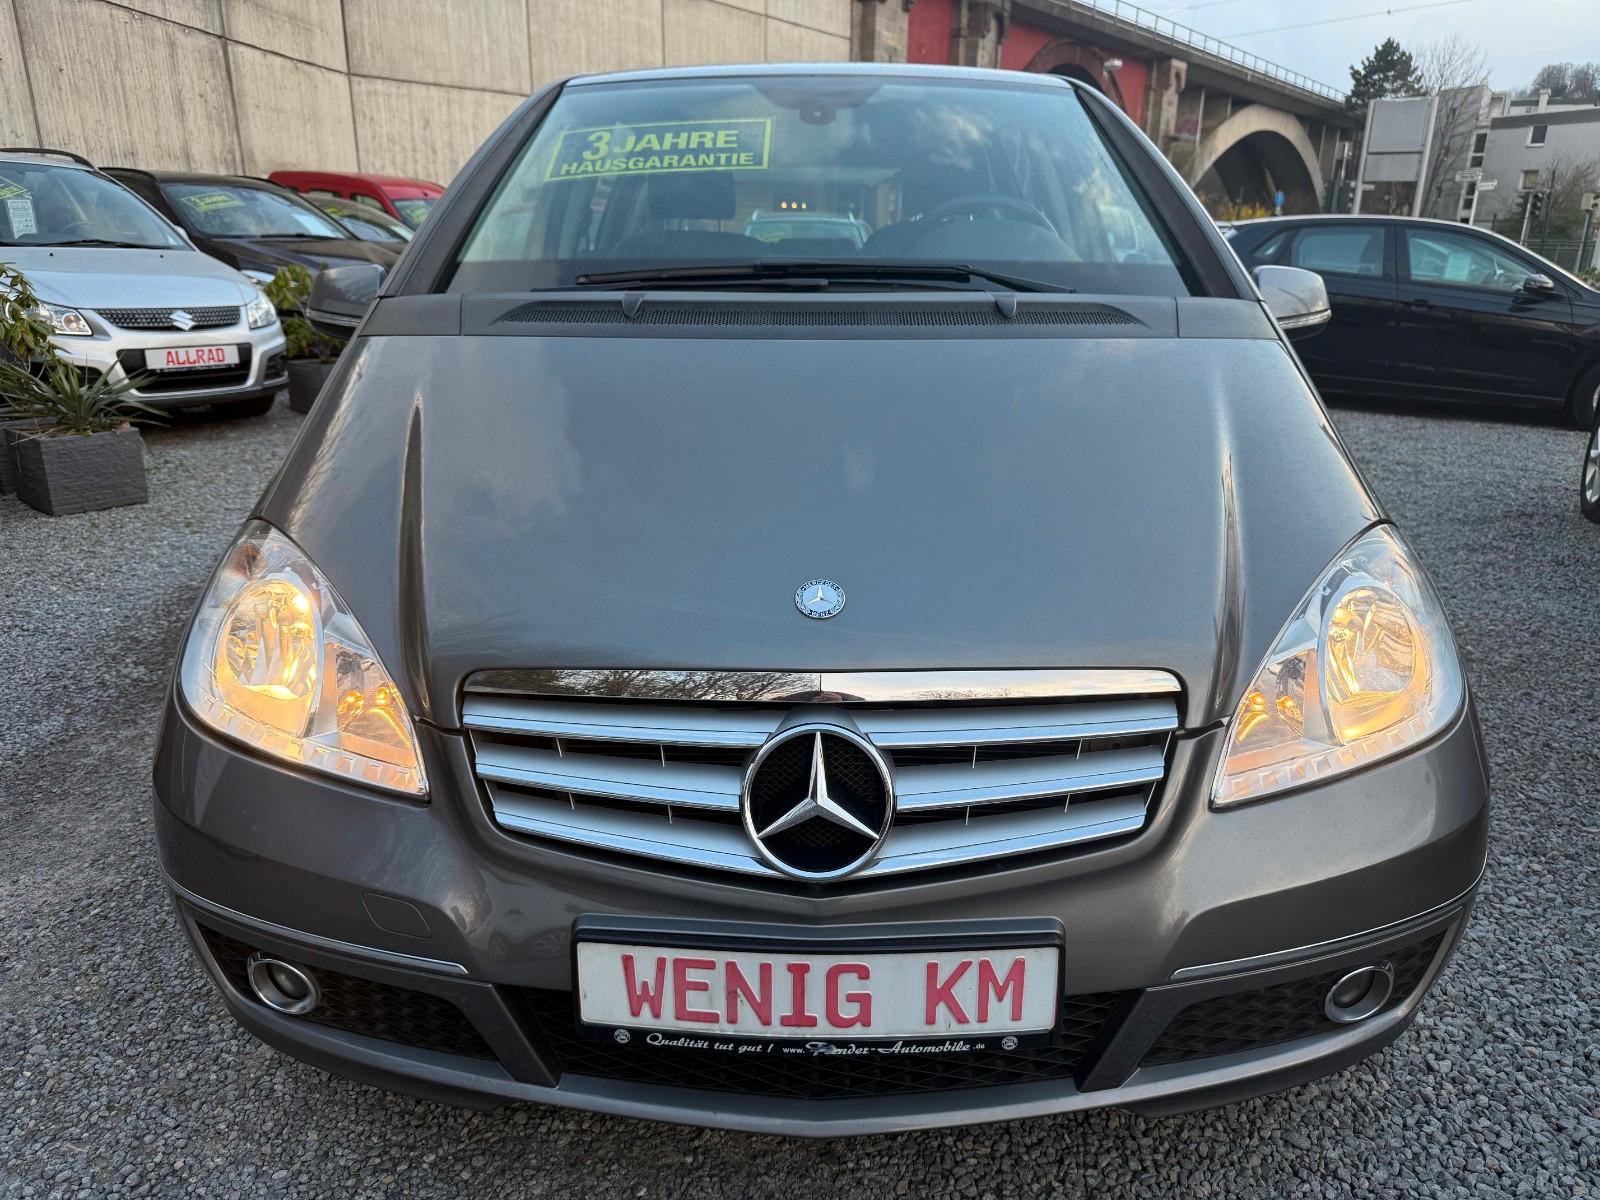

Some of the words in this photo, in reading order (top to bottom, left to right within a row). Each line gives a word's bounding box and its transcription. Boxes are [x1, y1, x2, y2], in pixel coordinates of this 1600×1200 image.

[582, 130, 612, 160] 3
[613, 130, 739, 153] JAHRE
[560, 153, 754, 175] HAUSGARANTIE
[166, 348, 226, 365] ALLRAD
[621, 954, 873, 1029] WENIG
[924, 956, 1026, 1026] KM
[646, 1032, 709, 1049] Qualität
[714, 1042, 734, 1051] tut
[738, 1043, 763, 1053] gut
